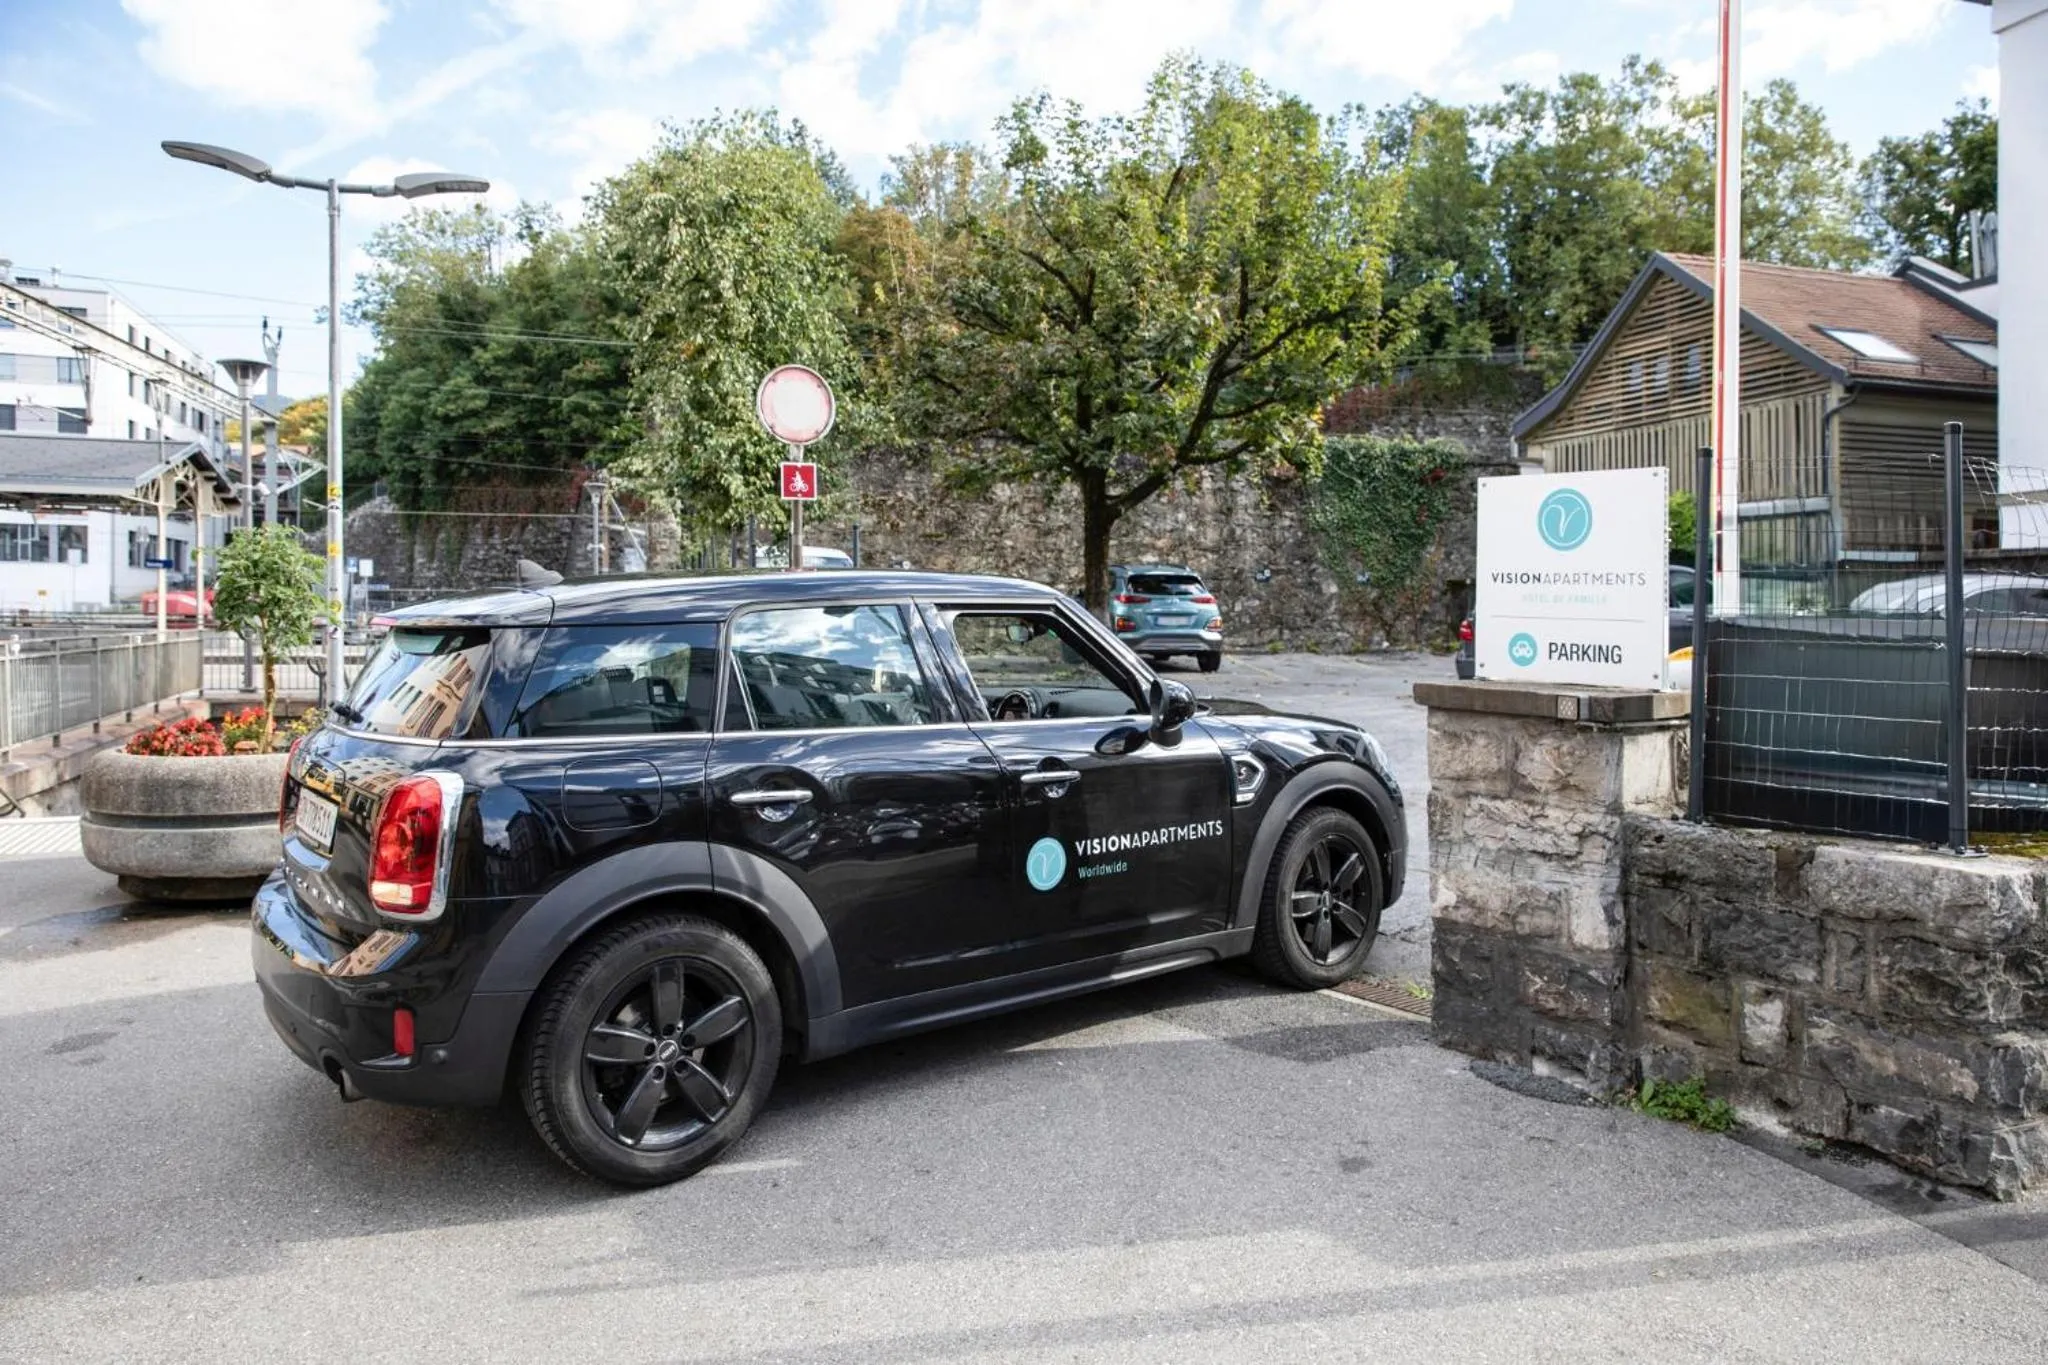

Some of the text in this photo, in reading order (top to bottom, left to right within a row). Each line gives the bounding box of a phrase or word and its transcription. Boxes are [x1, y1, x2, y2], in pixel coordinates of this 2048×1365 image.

[1491, 572, 1647, 587] VISIONAPARTMENTS
[1548, 641, 1623, 664] PARKING
[1075, 820, 1223, 856] VISIONAPARTMENTS
[1078, 861, 1128, 879] Worldwide
